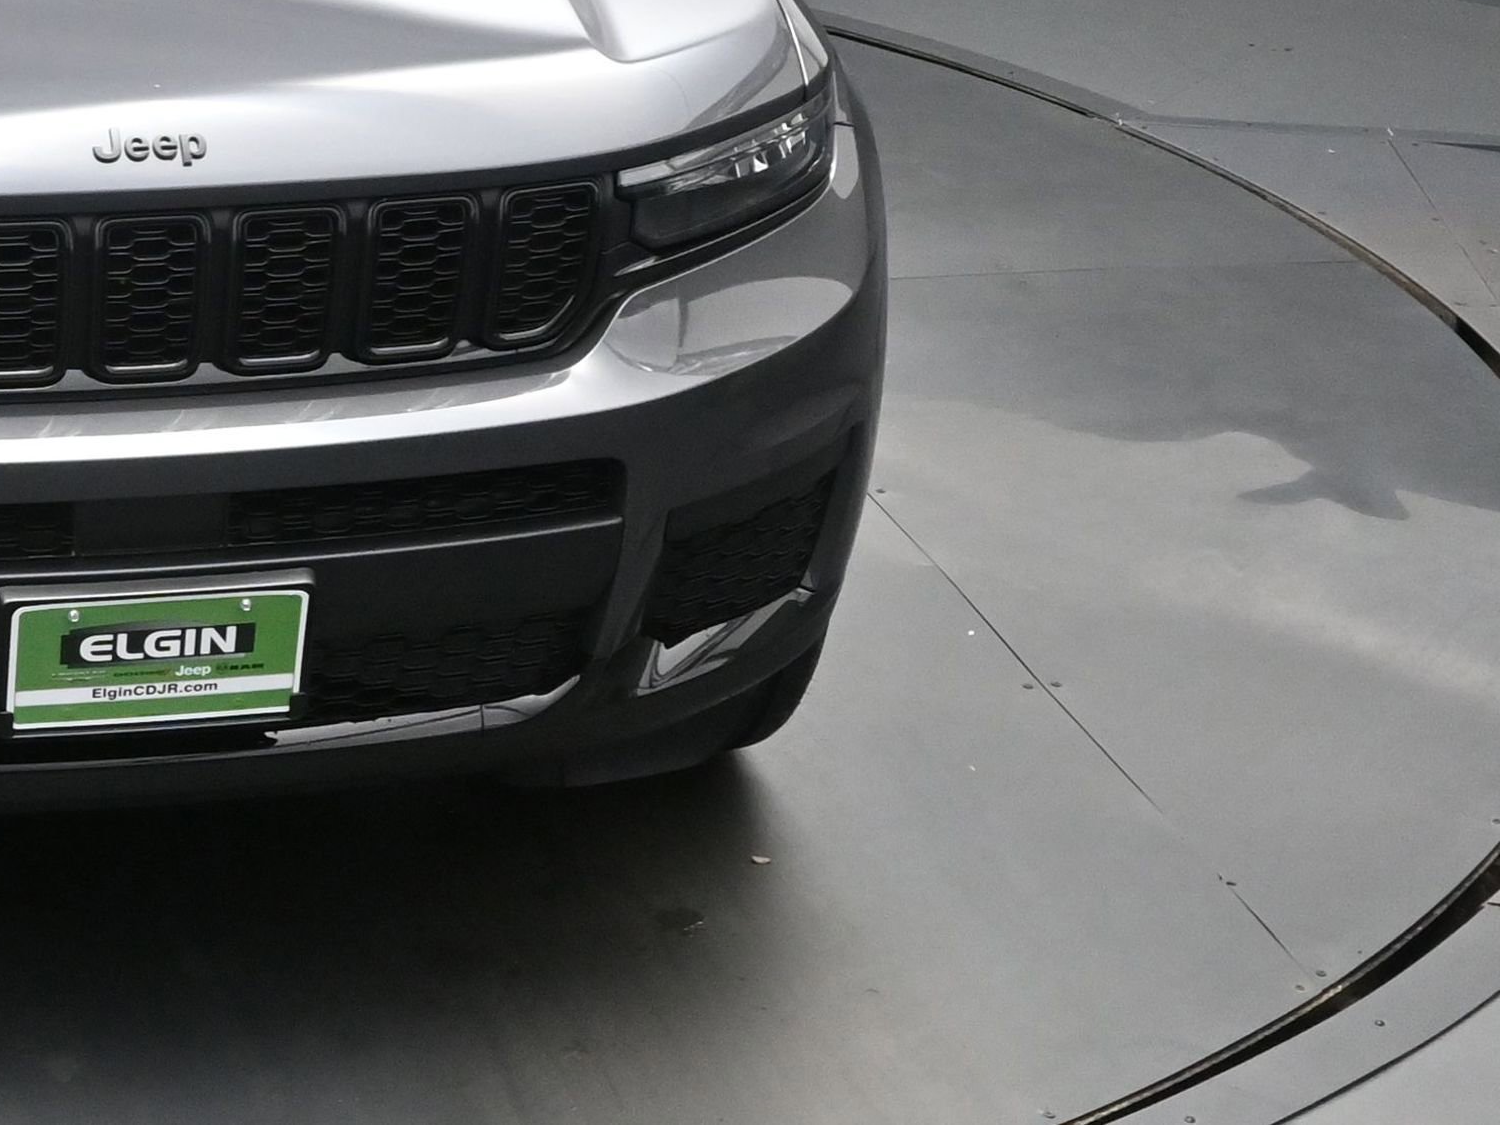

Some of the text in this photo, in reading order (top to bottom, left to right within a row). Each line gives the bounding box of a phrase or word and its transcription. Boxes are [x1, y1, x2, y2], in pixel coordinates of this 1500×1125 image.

[92, 128, 207, 167] Jeep
[79, 625, 237, 662] ELGIN
[175, 664, 211, 676] Jeep
[92, 680, 218, 700] ElginCDJR.com
